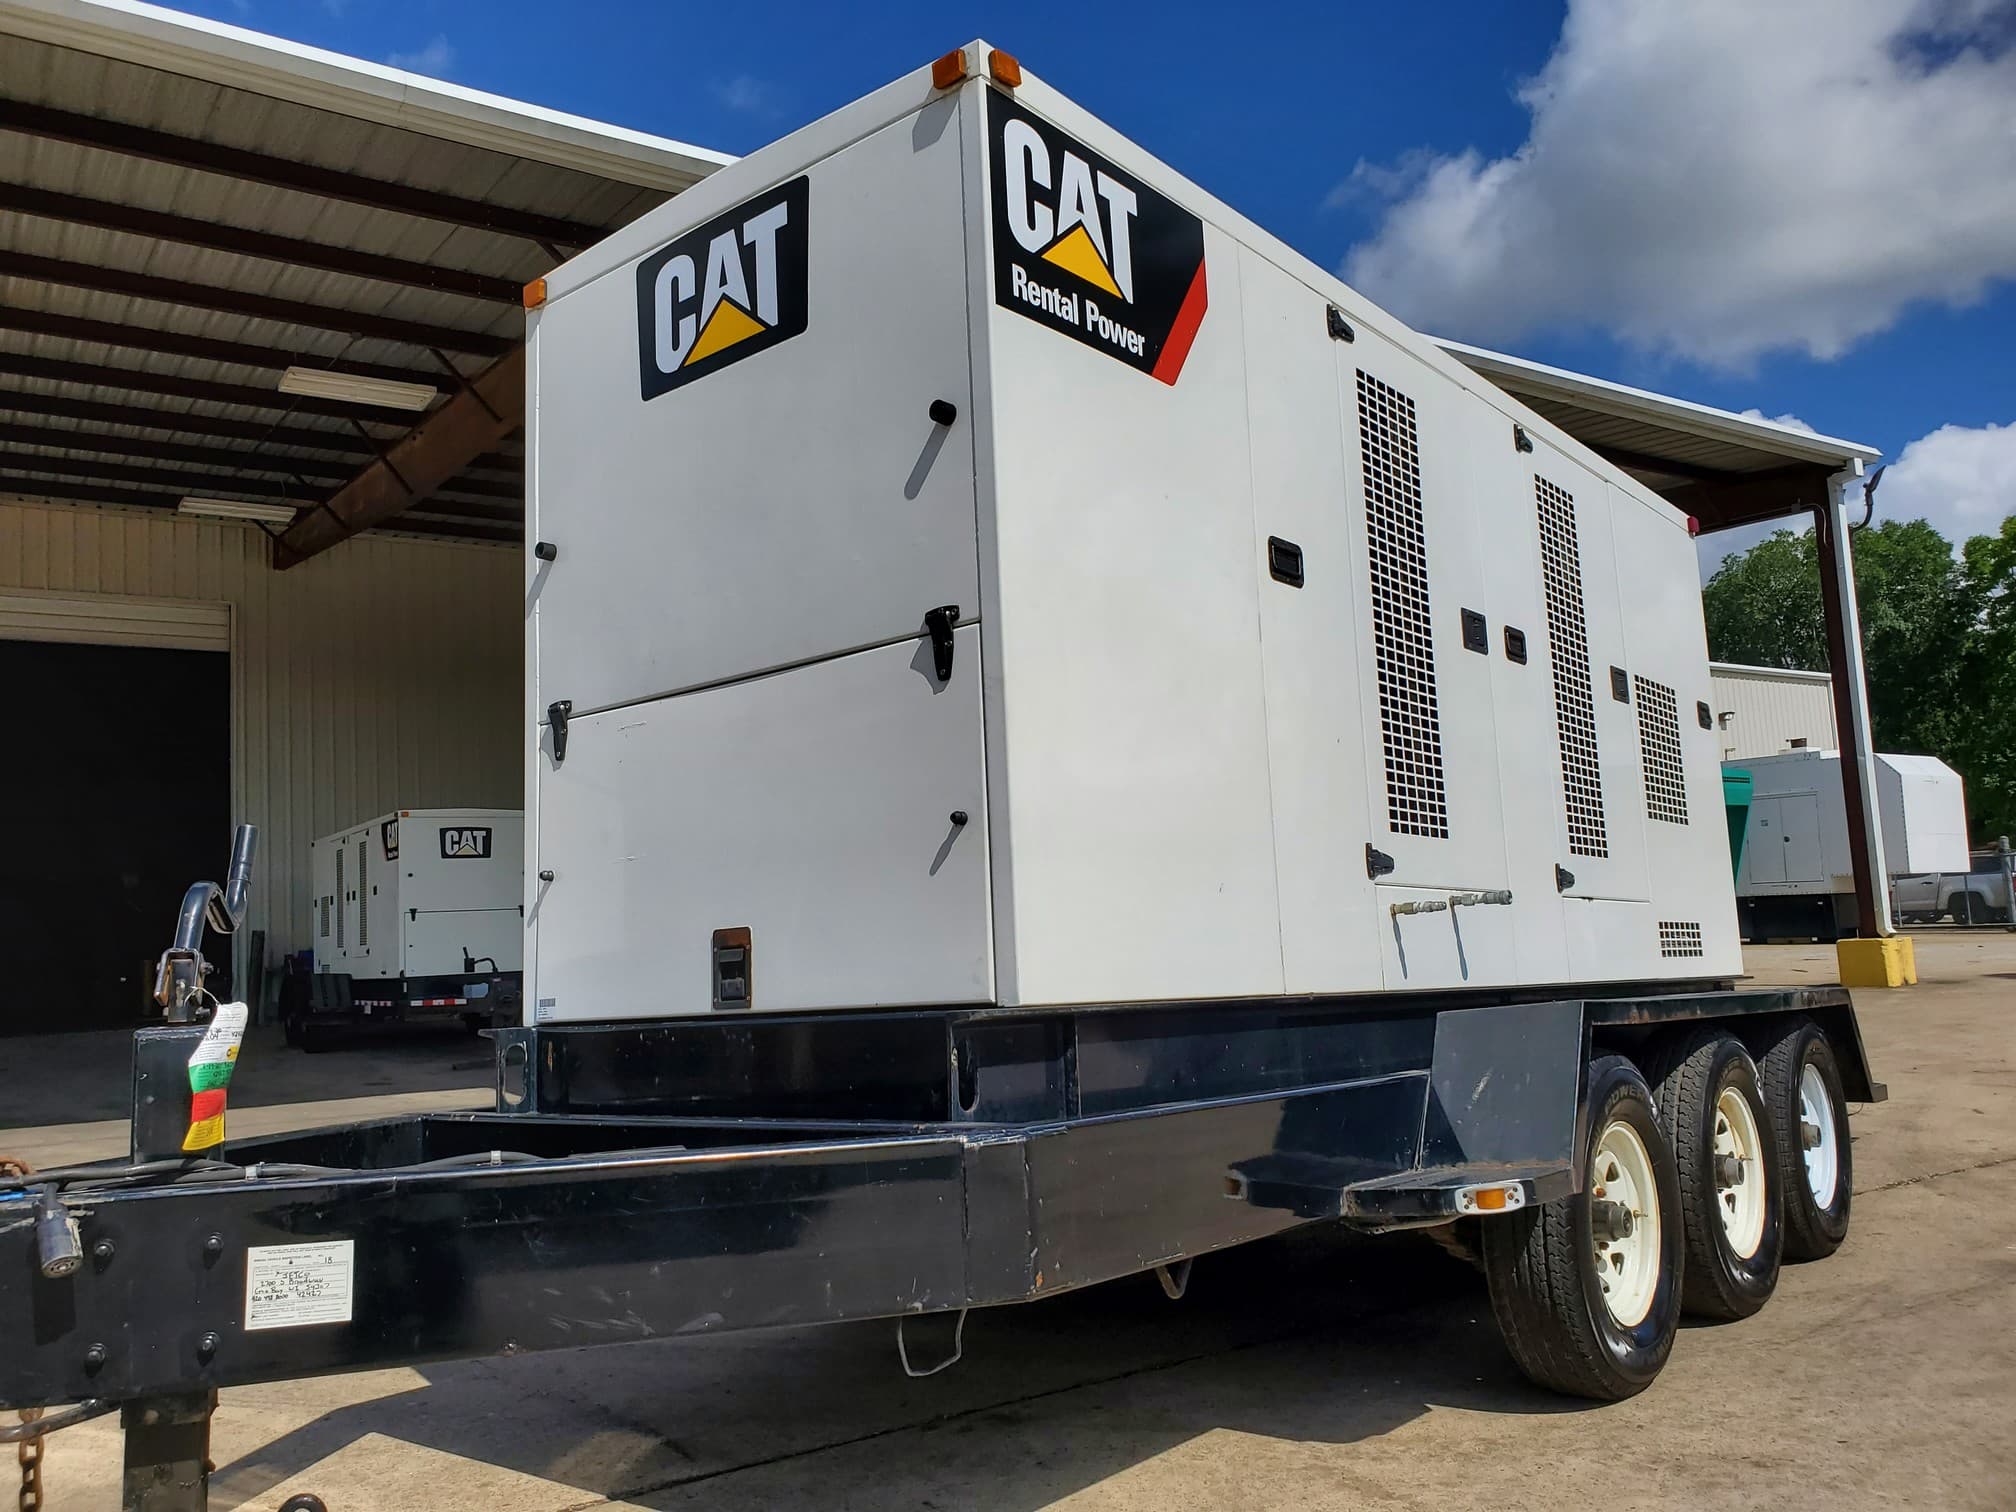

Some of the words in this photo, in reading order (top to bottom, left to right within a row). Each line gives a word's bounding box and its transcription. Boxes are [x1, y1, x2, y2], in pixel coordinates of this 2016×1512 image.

[1003, 118, 1137, 304] CAT
[653, 200, 788, 374] CAT
[1011, 262, 1080, 326] Rental
[1085, 298, 1146, 357] Power
[445, 830, 487, 856] CAT
